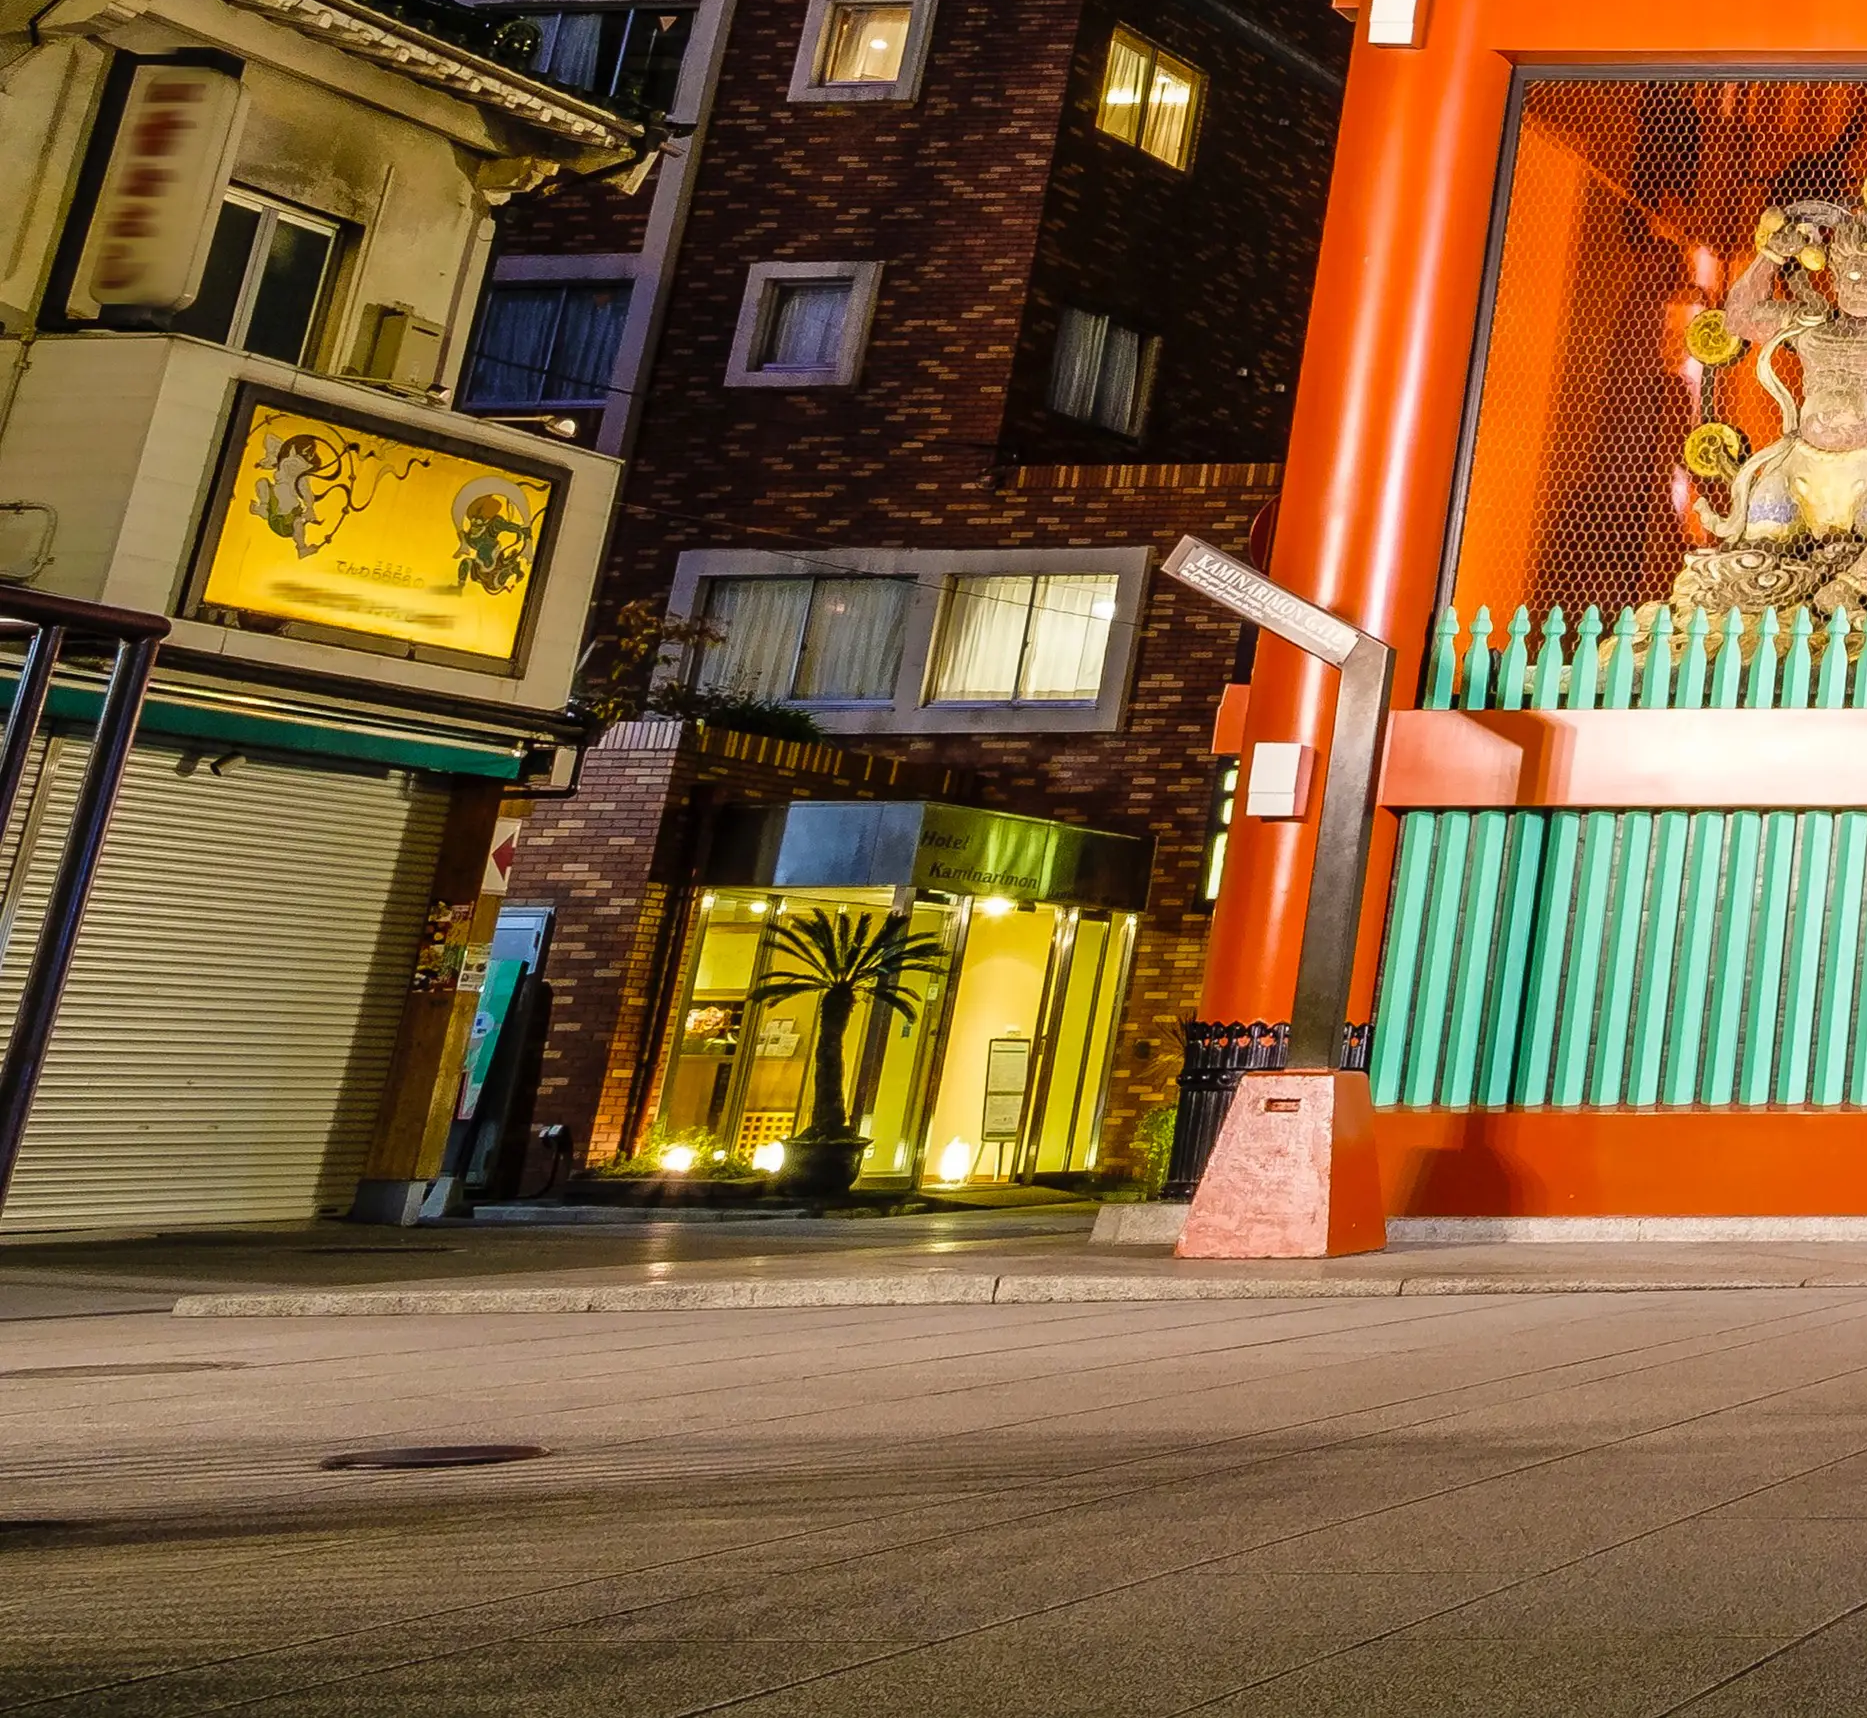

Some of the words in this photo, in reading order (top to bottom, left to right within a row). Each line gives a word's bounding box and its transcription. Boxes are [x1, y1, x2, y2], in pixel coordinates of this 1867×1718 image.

[1197, 553, 1308, 626] KAMINARIMON
[922, 830, 970, 851] Hotel
[929, 862, 1037, 889] Kaminarimon
